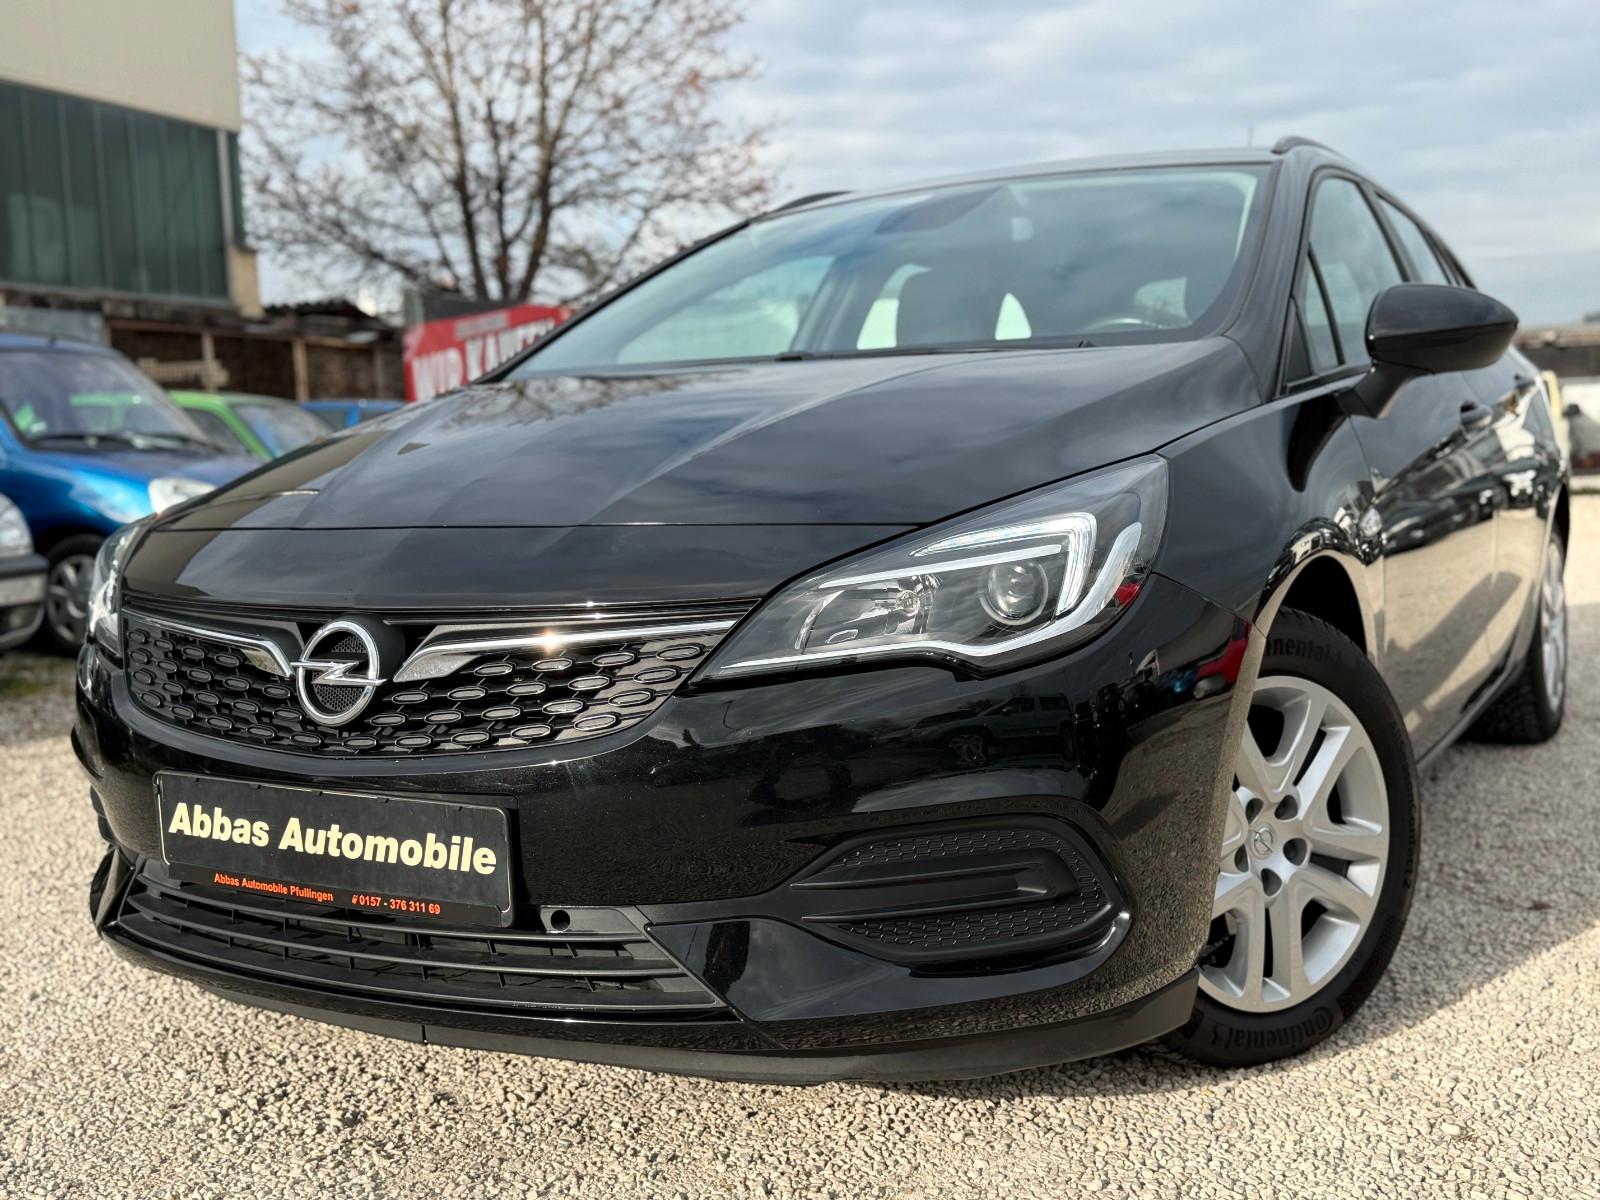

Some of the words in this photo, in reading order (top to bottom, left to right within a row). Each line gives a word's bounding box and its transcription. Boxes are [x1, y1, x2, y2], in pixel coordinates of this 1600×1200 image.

[169, 801, 269, 847] Abbas
[278, 817, 496, 874] Automobile
[214, 873, 240, 887] Abbas
[241, 878, 288, 895] Automobile
[290, 885, 334, 903] Pfullingen
[359, 895, 382, 908] 0157
[390, 898, 407, 911] 376
[408, 901, 426, 913] 311
[428, 903, 441, 915] 69
[1225, 1007, 1334, 1049] Continental
